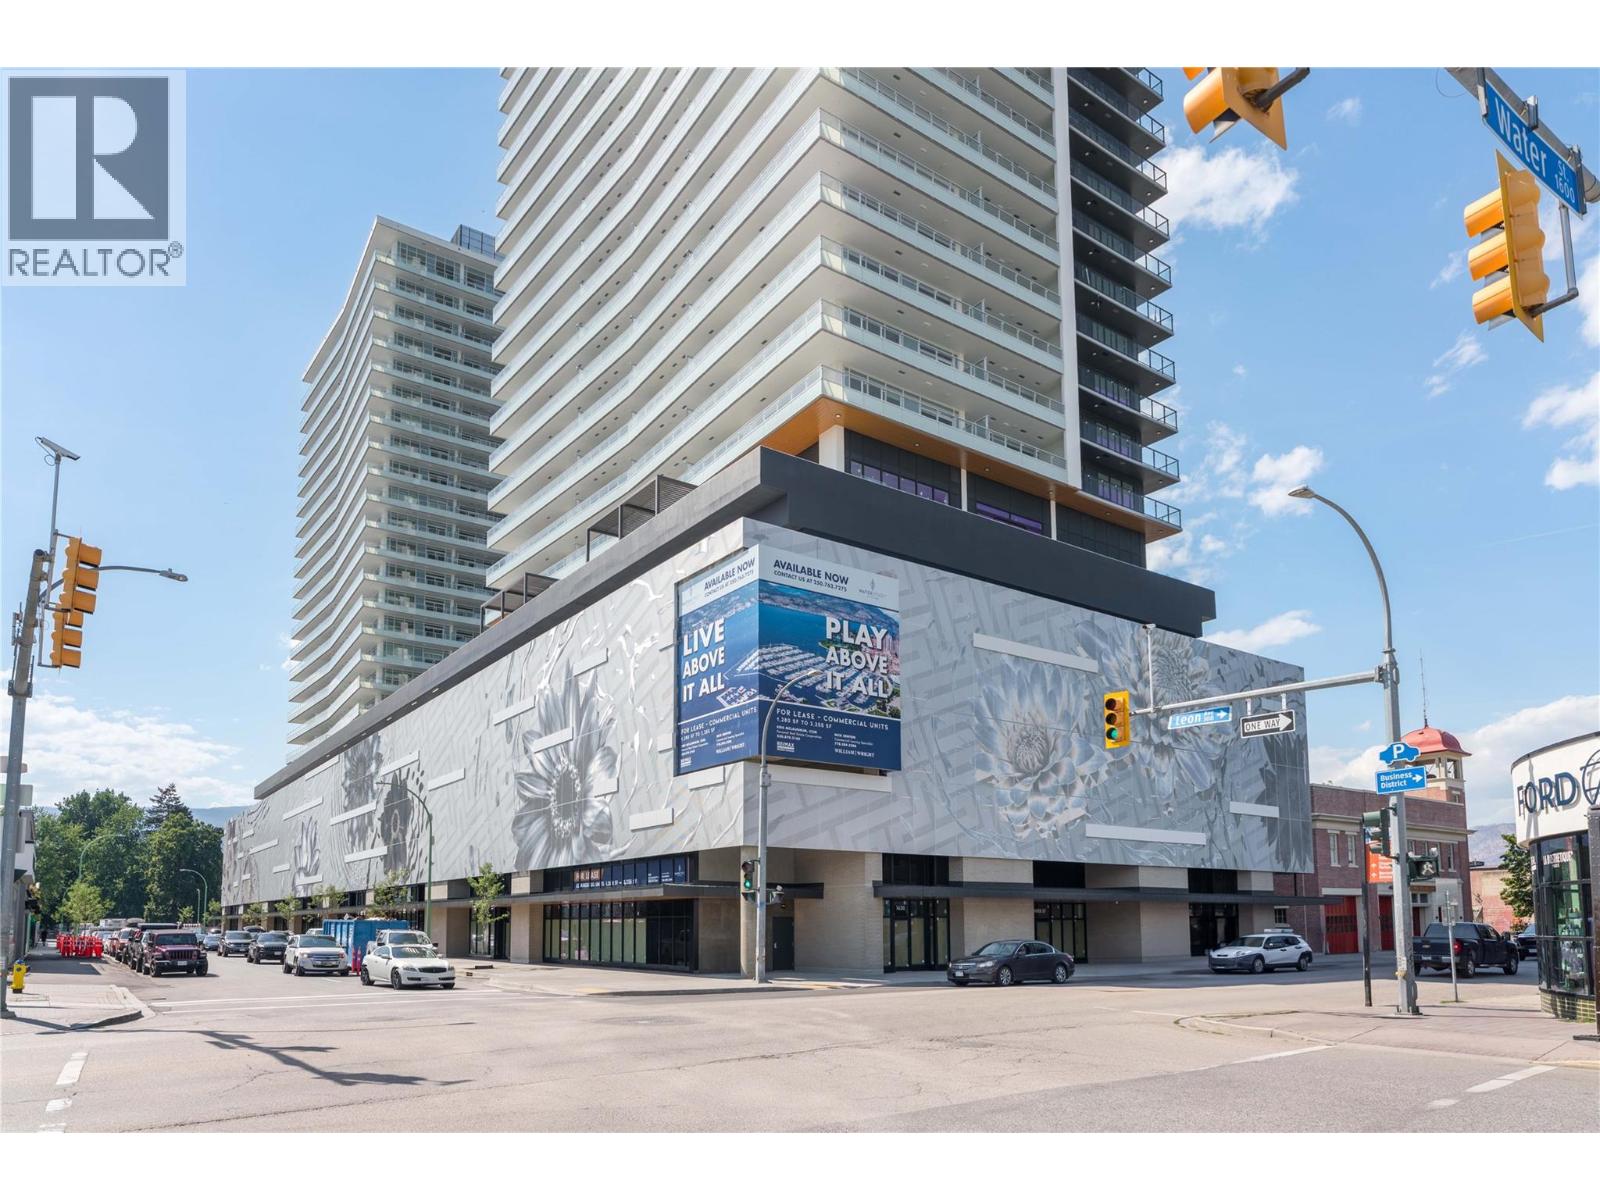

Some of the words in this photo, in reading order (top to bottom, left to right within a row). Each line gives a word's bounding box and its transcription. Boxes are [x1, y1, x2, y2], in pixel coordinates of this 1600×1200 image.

[1495, 97, 1547, 178] Water
[1555, 174, 1575, 203] 1600
[704, 568, 736, 590] AVAILABLE
[737, 557, 755, 573] NOW
[773, 559, 822, 579] AVAILABLE
[824, 571, 849, 585] NOW
[773, 570, 797, 580] CONTACT
[683, 617, 725, 657] LIVE
[826, 616, 888, 650] PLAY
[682, 646, 725, 679] ABOVE
[825, 646, 888, 674] ABOVE
[683, 682, 695, 703] IT
[699, 672, 725, 697] ALL
[826, 670, 845, 690] IT
[851, 675, 889, 698] ALL
[680, 727, 690, 735] FOR
[691, 723, 704, 732] LEASE
[709, 712, 740, 726] COMMERCIAL
[741, 706, 757, 716] UNITS
[776, 708, 791, 716] FOR
[793, 710, 815, 719] LEASE
[823, 715, 867, 728] COMMERCIAL
[869, 721, 889, 730] UNITS
[1175, 713, 1201, 726] Leon
[1245, 721, 1260, 731] ONE
[1264, 718, 1280, 729] WAY
[1392, 744, 1405, 759] P
[1380, 772, 1413, 781] Business
[1380, 779, 1407, 789] District
[1517, 772, 1577, 817] FORD
